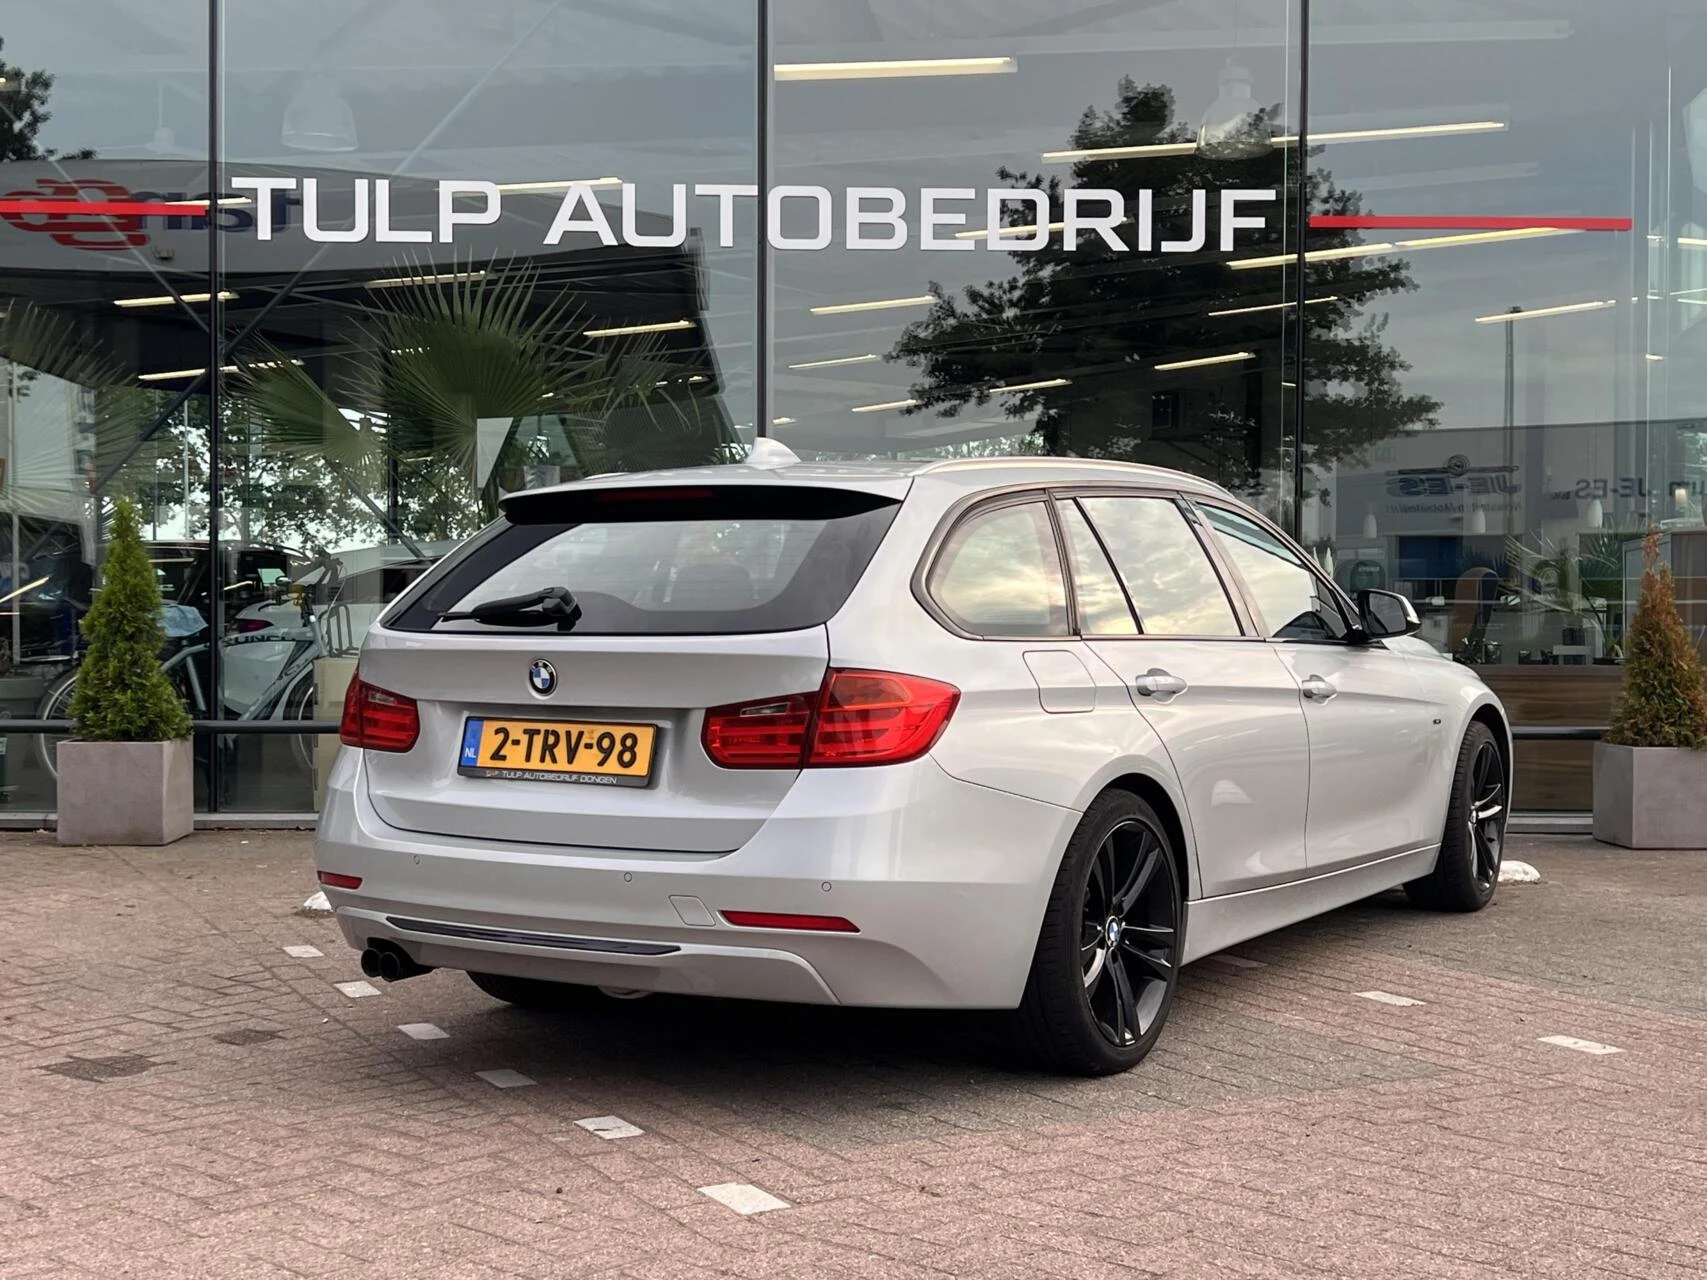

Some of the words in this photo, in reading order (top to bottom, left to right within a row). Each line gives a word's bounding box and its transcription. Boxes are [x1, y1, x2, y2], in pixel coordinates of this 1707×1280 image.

[231, 177, 501, 244] TULP
[542, 182, 1277, 252] AUTOBEDRIJF
[464, 748, 477, 759] NL
[490, 727, 638, 768] 2-TRV-98
[503, 770, 523, 779] TULP
[524, 772, 579, 782] AUTOBEDRIJF
[580, 775, 618, 785] DONGEN
